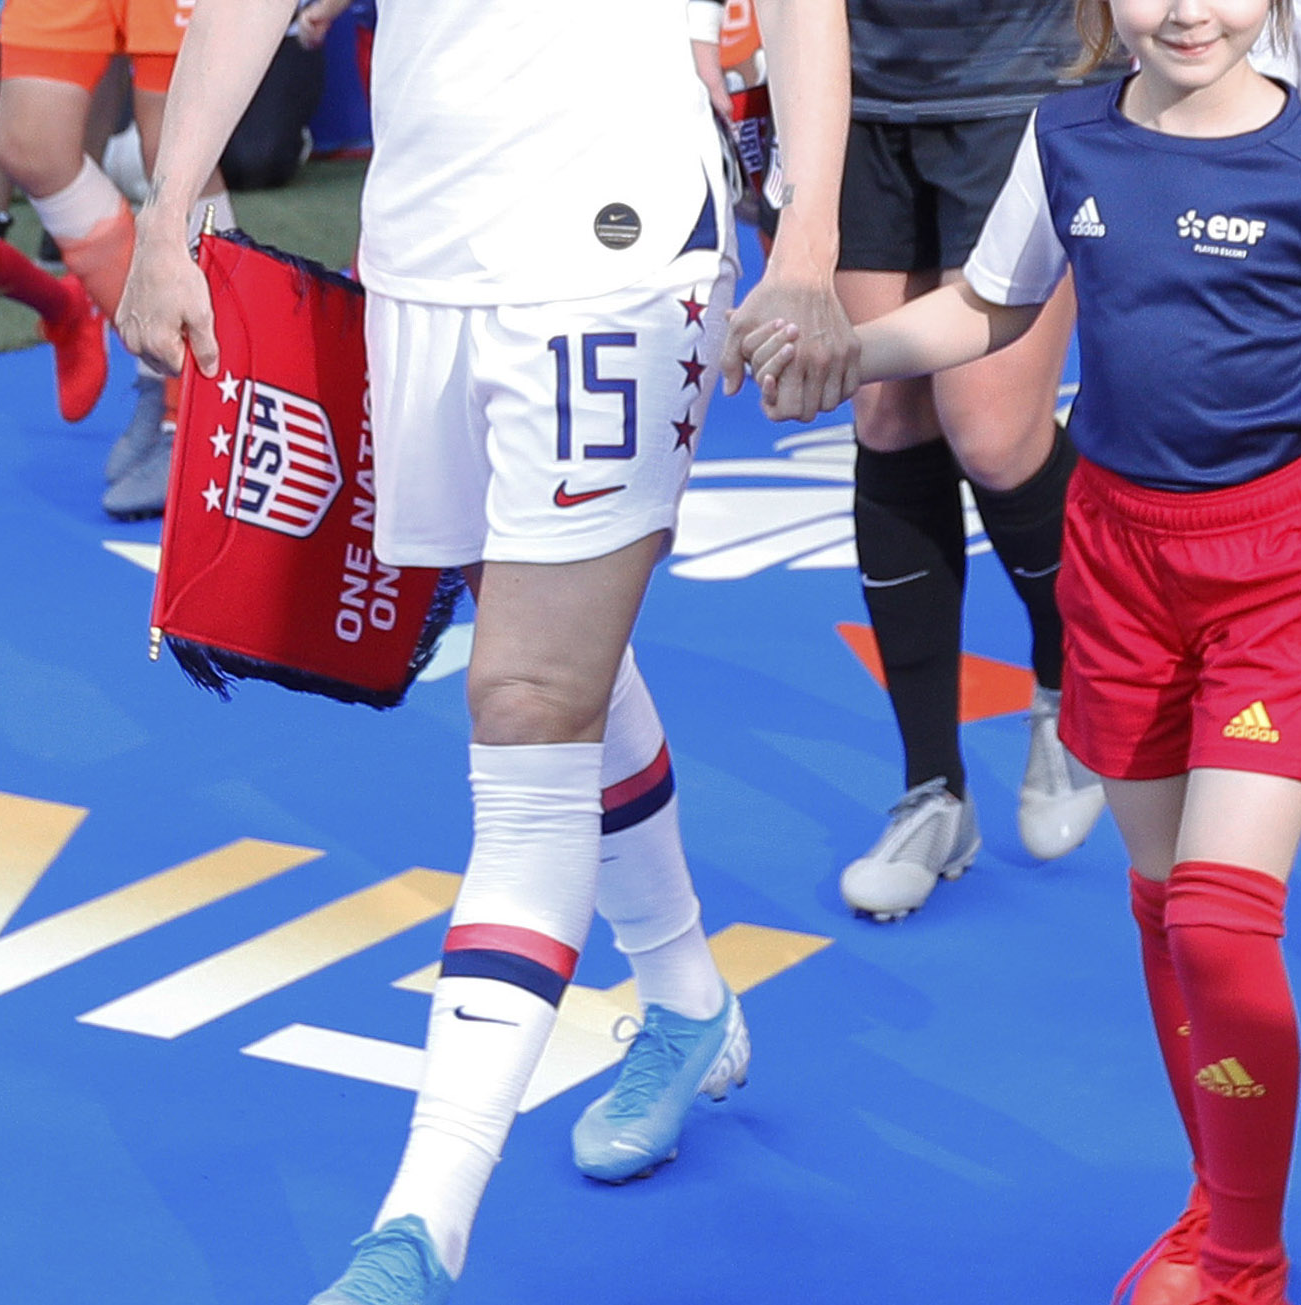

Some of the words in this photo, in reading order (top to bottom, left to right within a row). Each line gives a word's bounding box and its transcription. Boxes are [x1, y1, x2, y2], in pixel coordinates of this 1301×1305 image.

[1070, 223, 1106, 238] adidas
[548, 331, 637, 461] 15
[234, 392, 283, 514] USA
[335, 543, 373, 643] ONE
[1223, 723, 1280, 744] adidas
